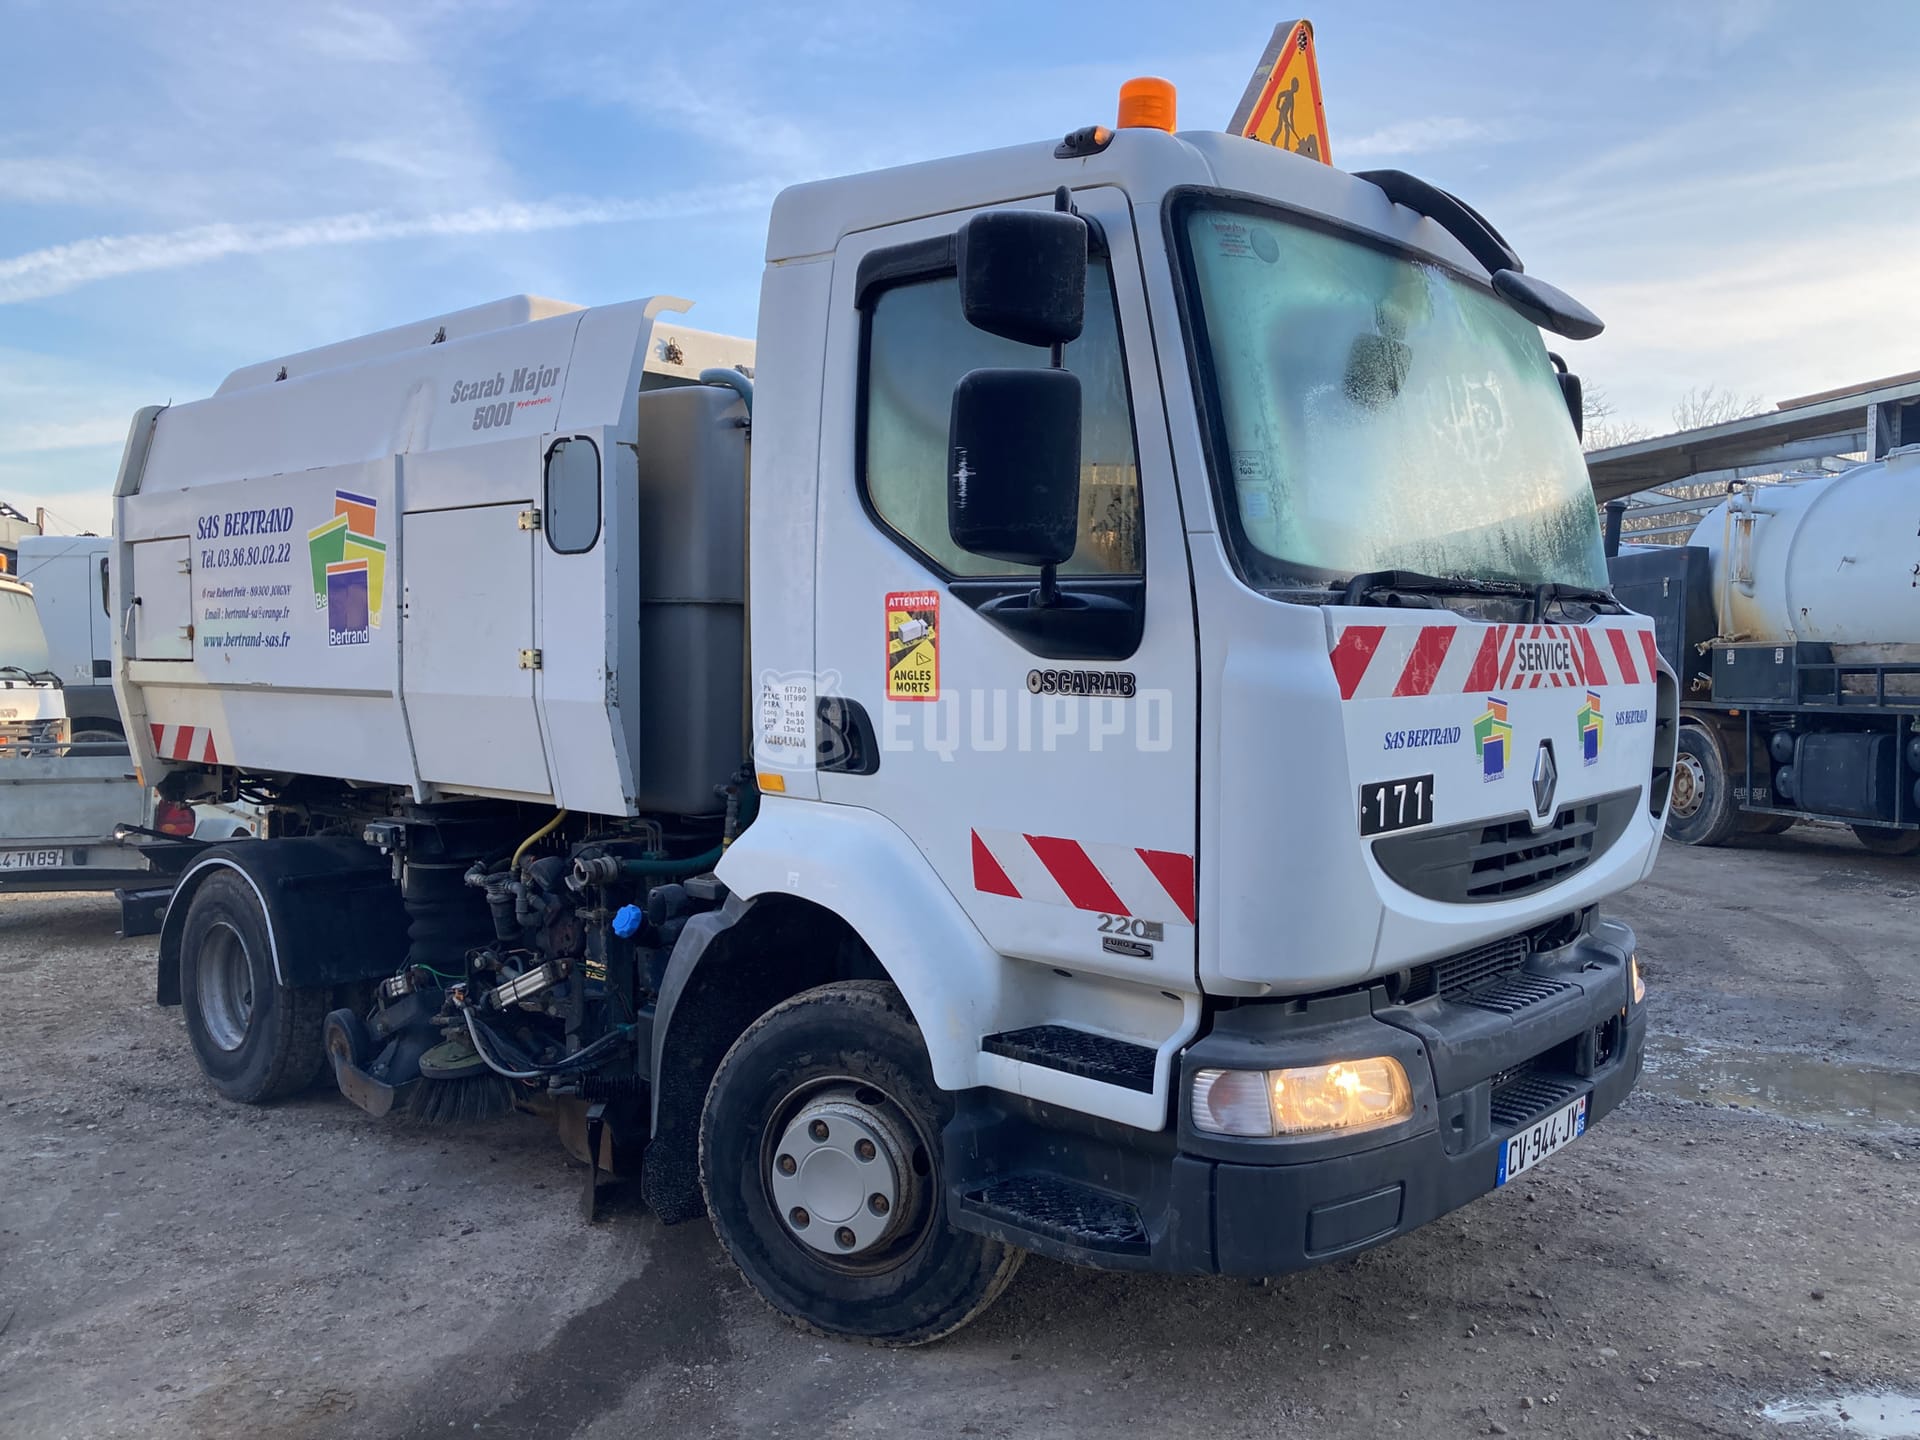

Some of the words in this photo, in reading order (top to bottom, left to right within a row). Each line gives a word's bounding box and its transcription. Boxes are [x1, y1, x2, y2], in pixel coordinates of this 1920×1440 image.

[451, 372, 504, 404] Scarab
[509, 365, 560, 395] Major
[197, 514, 221, 541] SAS
[223, 506, 294, 537] BERTRAND
[201, 549, 217, 569] Tél.
[217, 543, 291, 568] 03.86.80.02.22
[206, 589, 216, 599] rue
[888, 595, 937, 607] ATTENTION
[203, 632, 291, 648] www.bertrand-sas.fr
[329, 626, 369, 645] Bertrand
[1517, 642, 1570, 672] SERVICE
[893, 669, 932, 681] ANGLES
[896, 681, 930, 693] MORTS
[1383, 729, 1406, 750] SAS
[1406, 726, 1461, 748] BERTRAND
[1375, 781, 1424, 828] 171
[1097, 914, 1146, 938] 220
[1105, 937, 1130, 948] EURO
